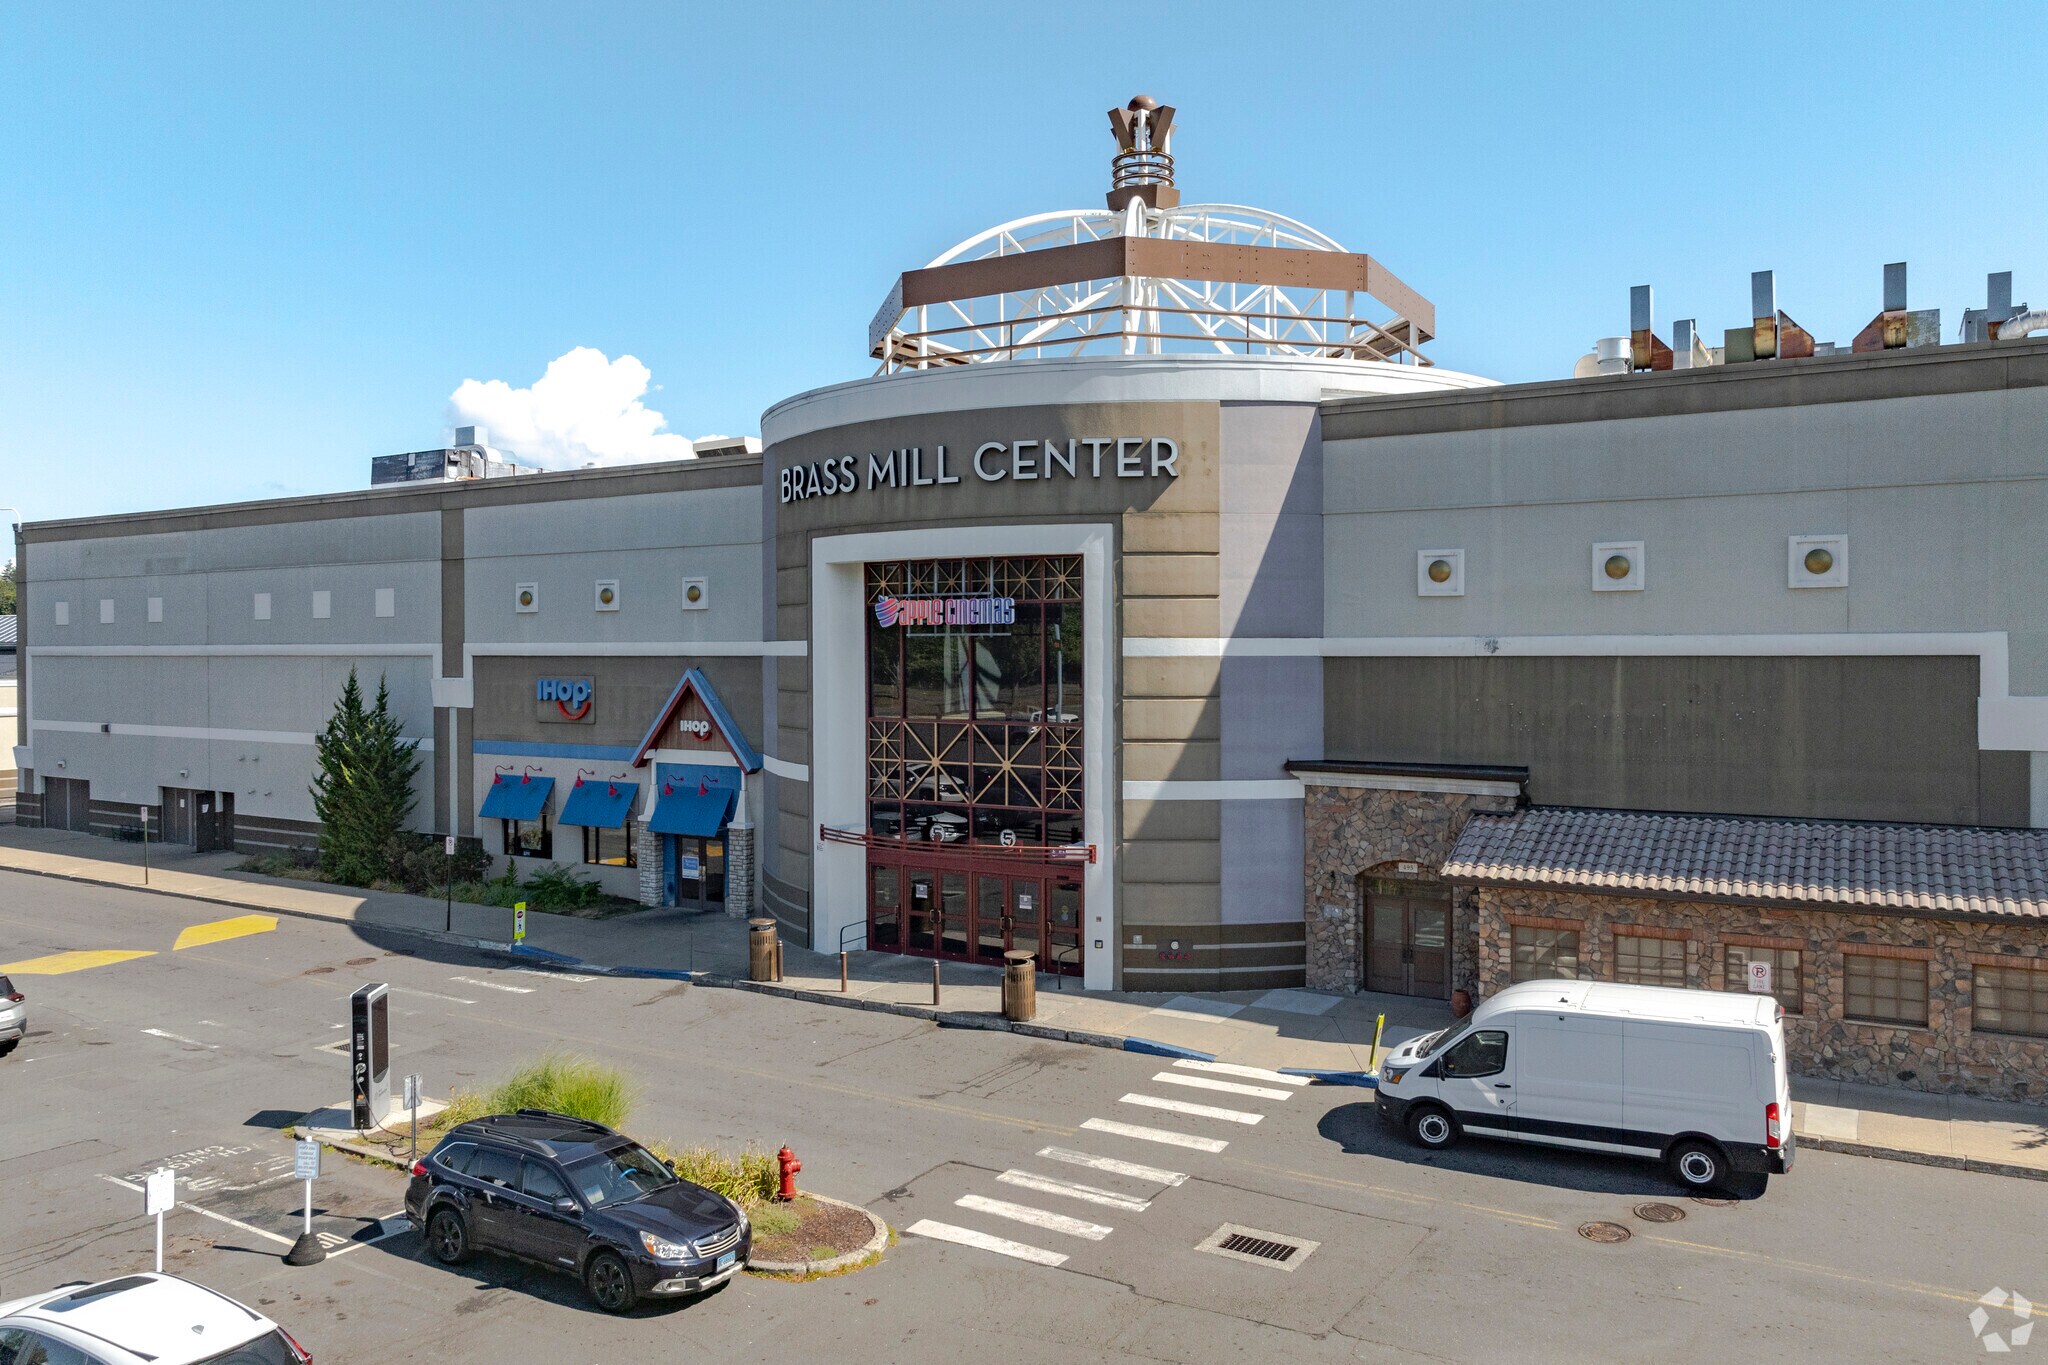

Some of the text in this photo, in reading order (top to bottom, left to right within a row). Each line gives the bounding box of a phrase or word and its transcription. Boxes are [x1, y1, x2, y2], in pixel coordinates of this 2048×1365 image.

[780, 437, 1180, 503] BRASS MILL CENTER
